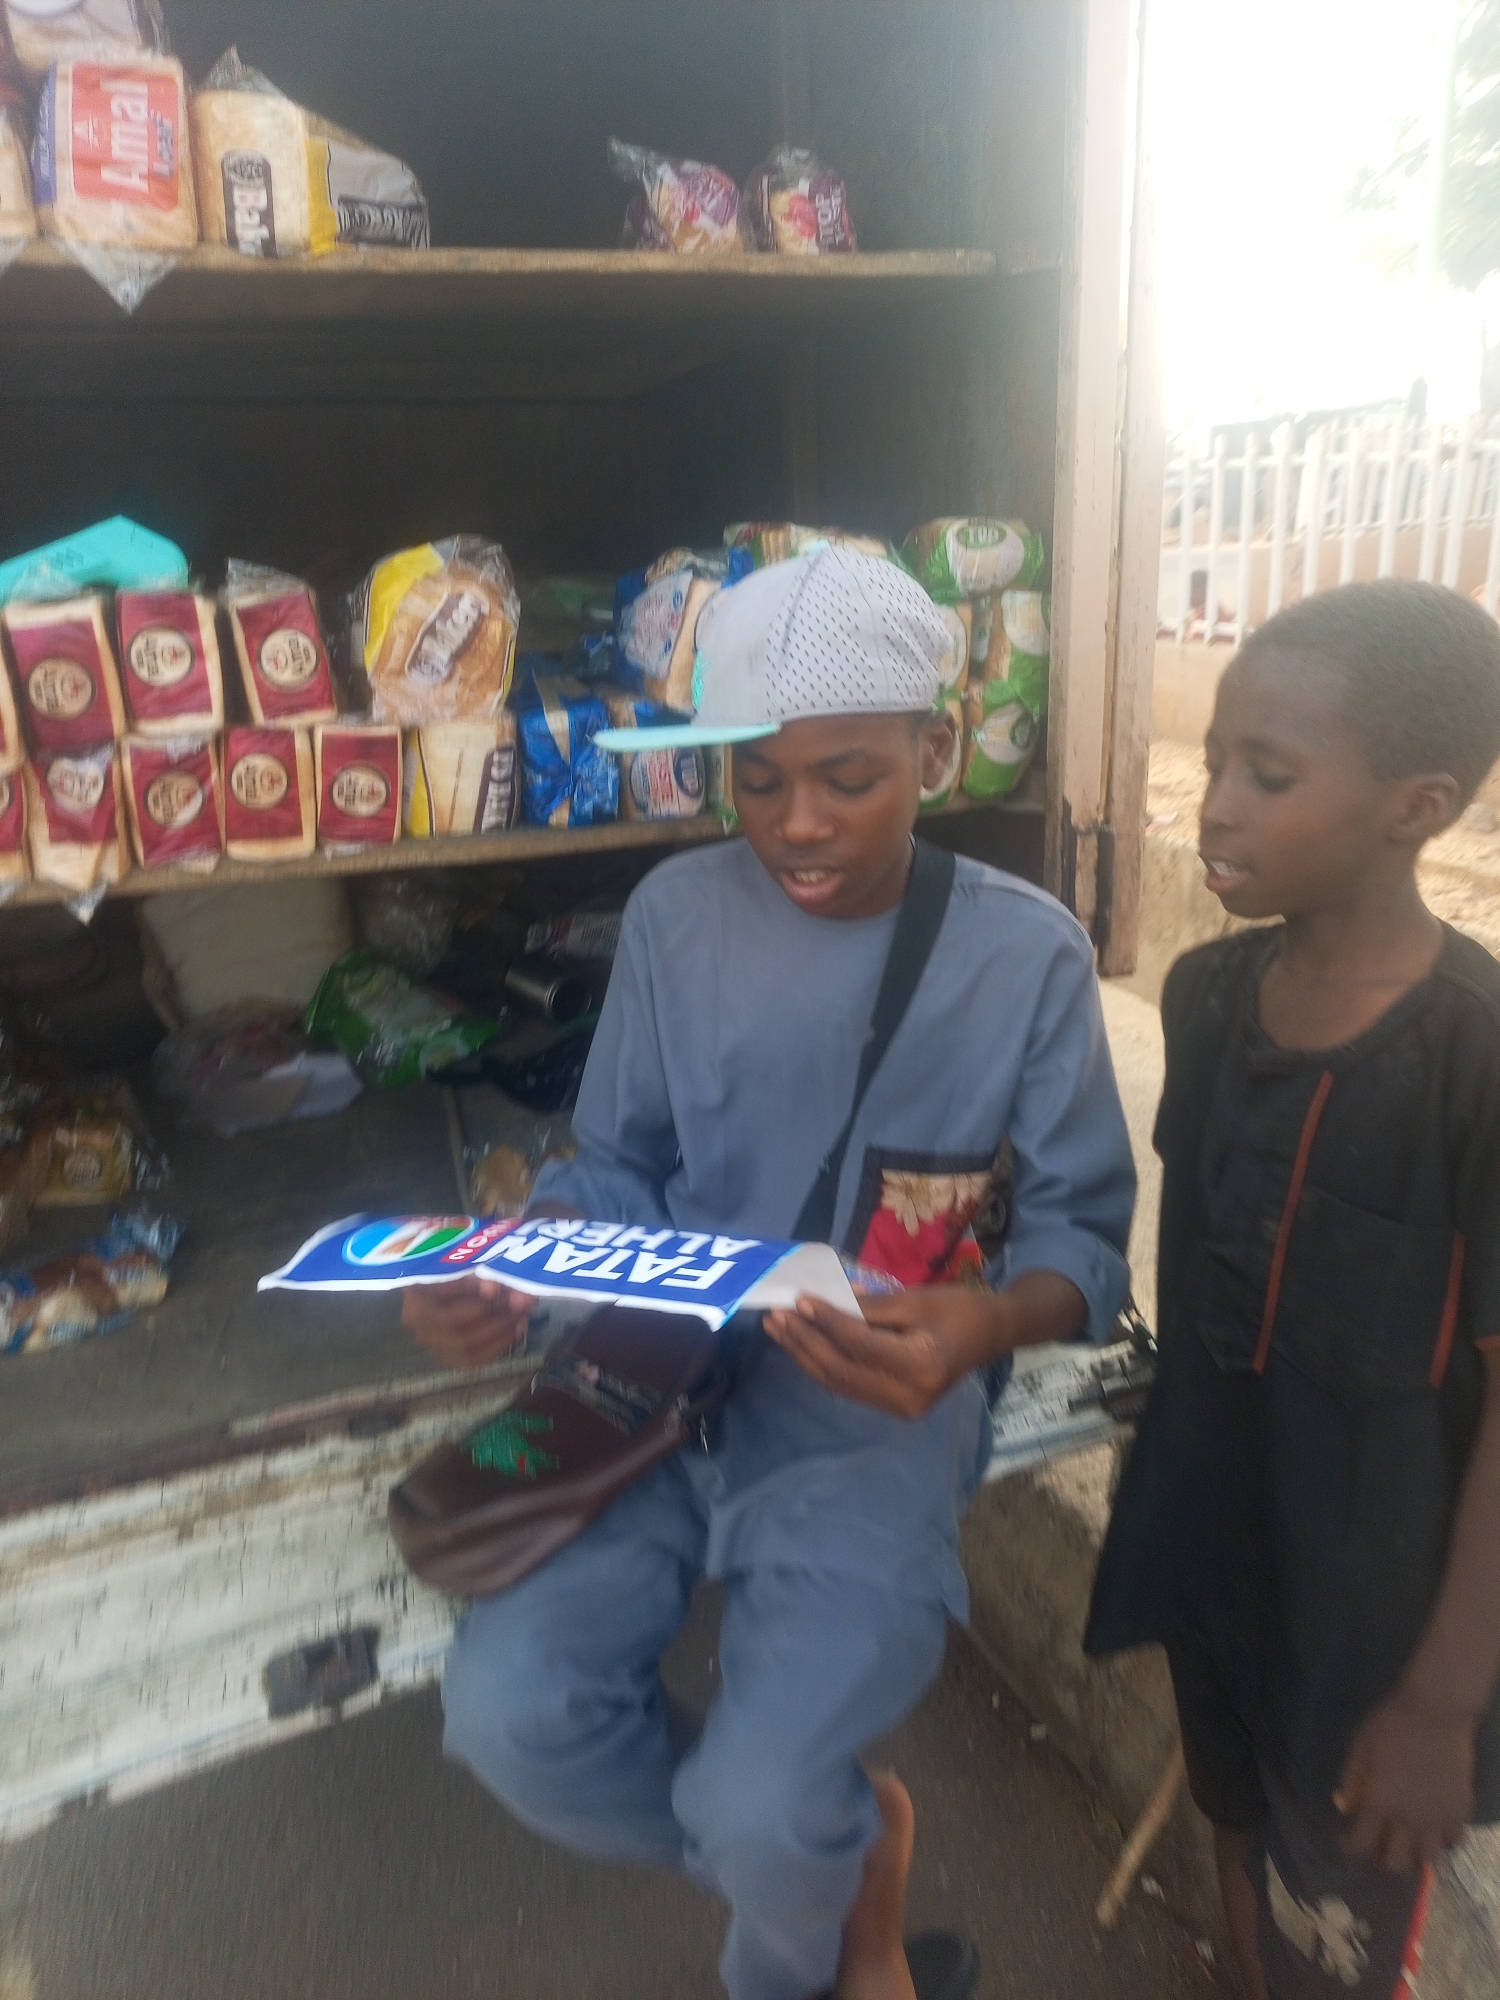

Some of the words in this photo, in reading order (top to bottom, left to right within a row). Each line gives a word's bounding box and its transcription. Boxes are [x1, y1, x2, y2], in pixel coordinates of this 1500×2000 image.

[101, 80, 149, 194] Amal
[471, 1233, 738, 1291] FATAN
[514, 1217, 764, 1259] ALHERI
